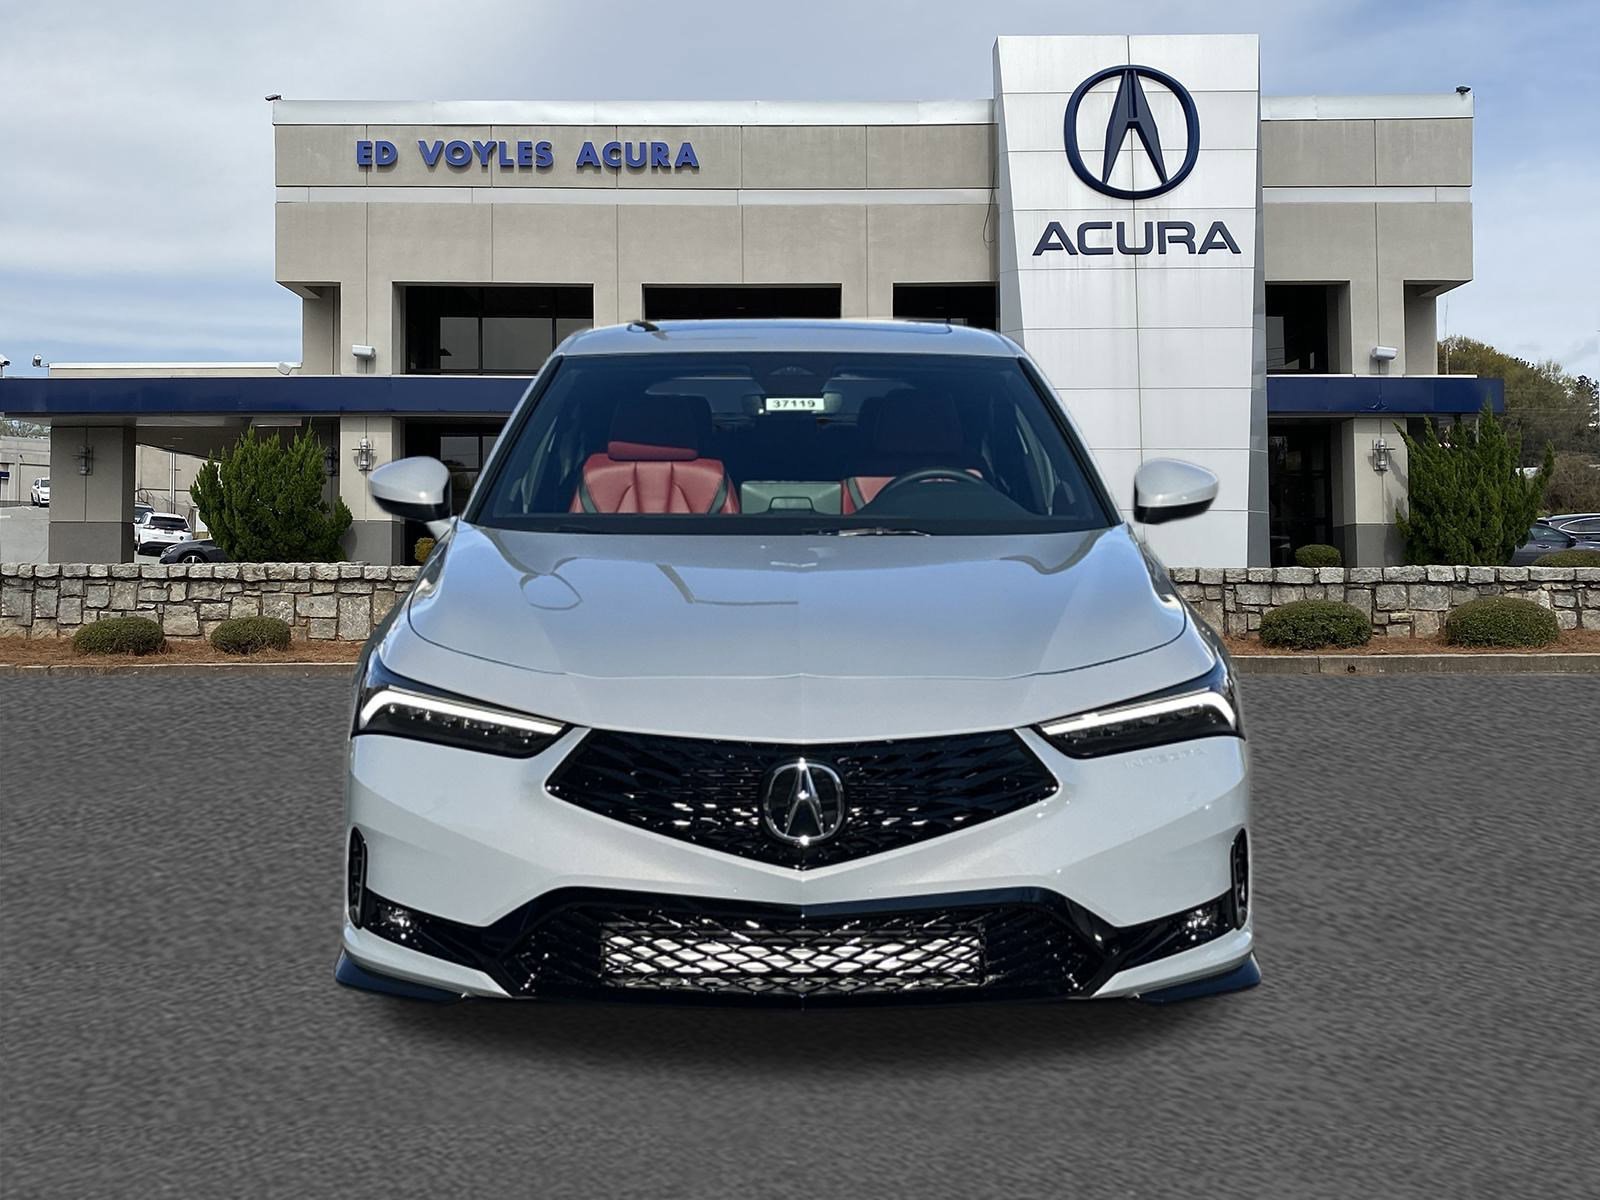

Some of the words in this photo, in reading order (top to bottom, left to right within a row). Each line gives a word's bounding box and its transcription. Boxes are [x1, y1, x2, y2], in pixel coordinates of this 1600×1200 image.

[356, 140, 398, 167] ED
[418, 140, 554, 168] VOYLES
[576, 141, 700, 169] ACURA
[1032, 221, 1242, 256] ACURA
[772, 399, 816, 408] 37119
